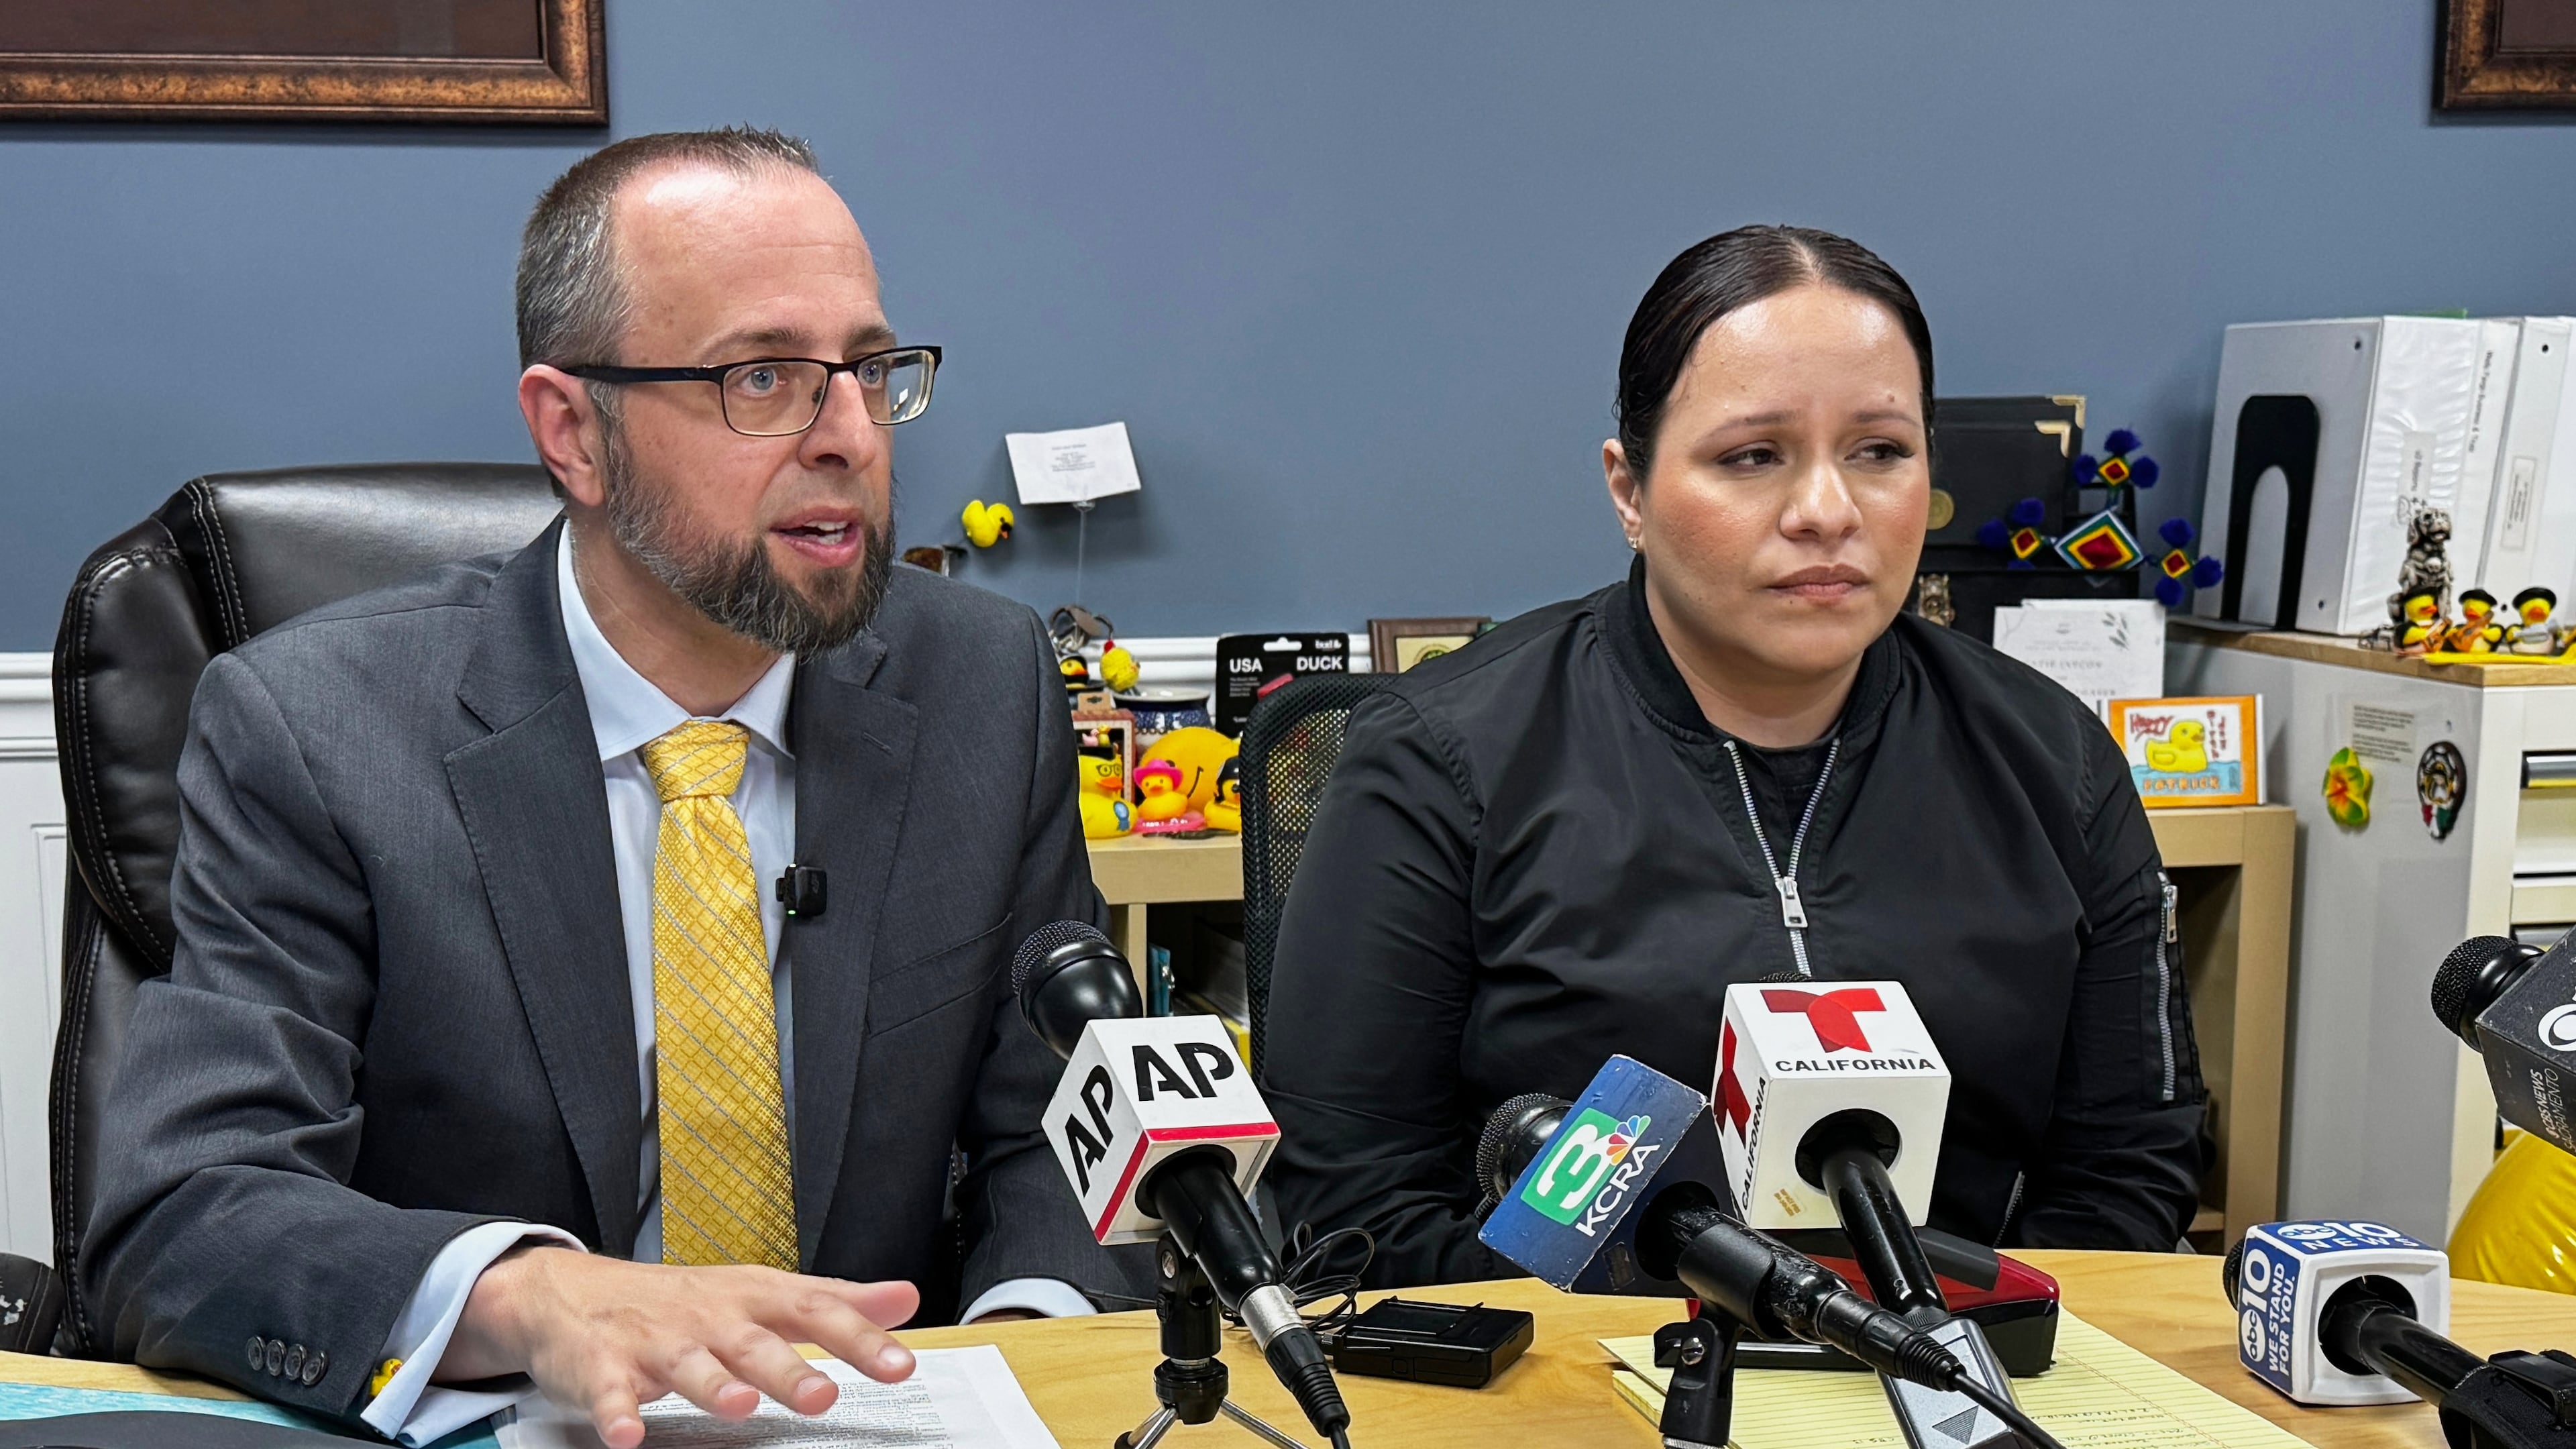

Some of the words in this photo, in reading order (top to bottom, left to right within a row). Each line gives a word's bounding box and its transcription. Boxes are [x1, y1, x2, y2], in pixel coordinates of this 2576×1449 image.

[1230, 657, 1263, 673] USA
[1296, 655, 1343, 671] DUCK
[1132, 1042, 1235, 1102] AP
[1775, 1059, 1937, 1071] CALIFORNIA
[2530, 1068, 2549, 1110] NEWS
[1064, 1064, 1114, 1198] AP
[1741, 1076, 1766, 1211] CALIFORNIA
[1536, 1123, 1616, 1210] 3
[1575, 1144, 1660, 1238] KCRA
[2302, 1237, 2419, 1250] NEWS
[2269, 1263, 2285, 1336] STAND
[2279, 1275, 2296, 1324] YOU.
[2268, 1338, 2279, 1372] WE
[2279, 1330, 2290, 1377] FOR
